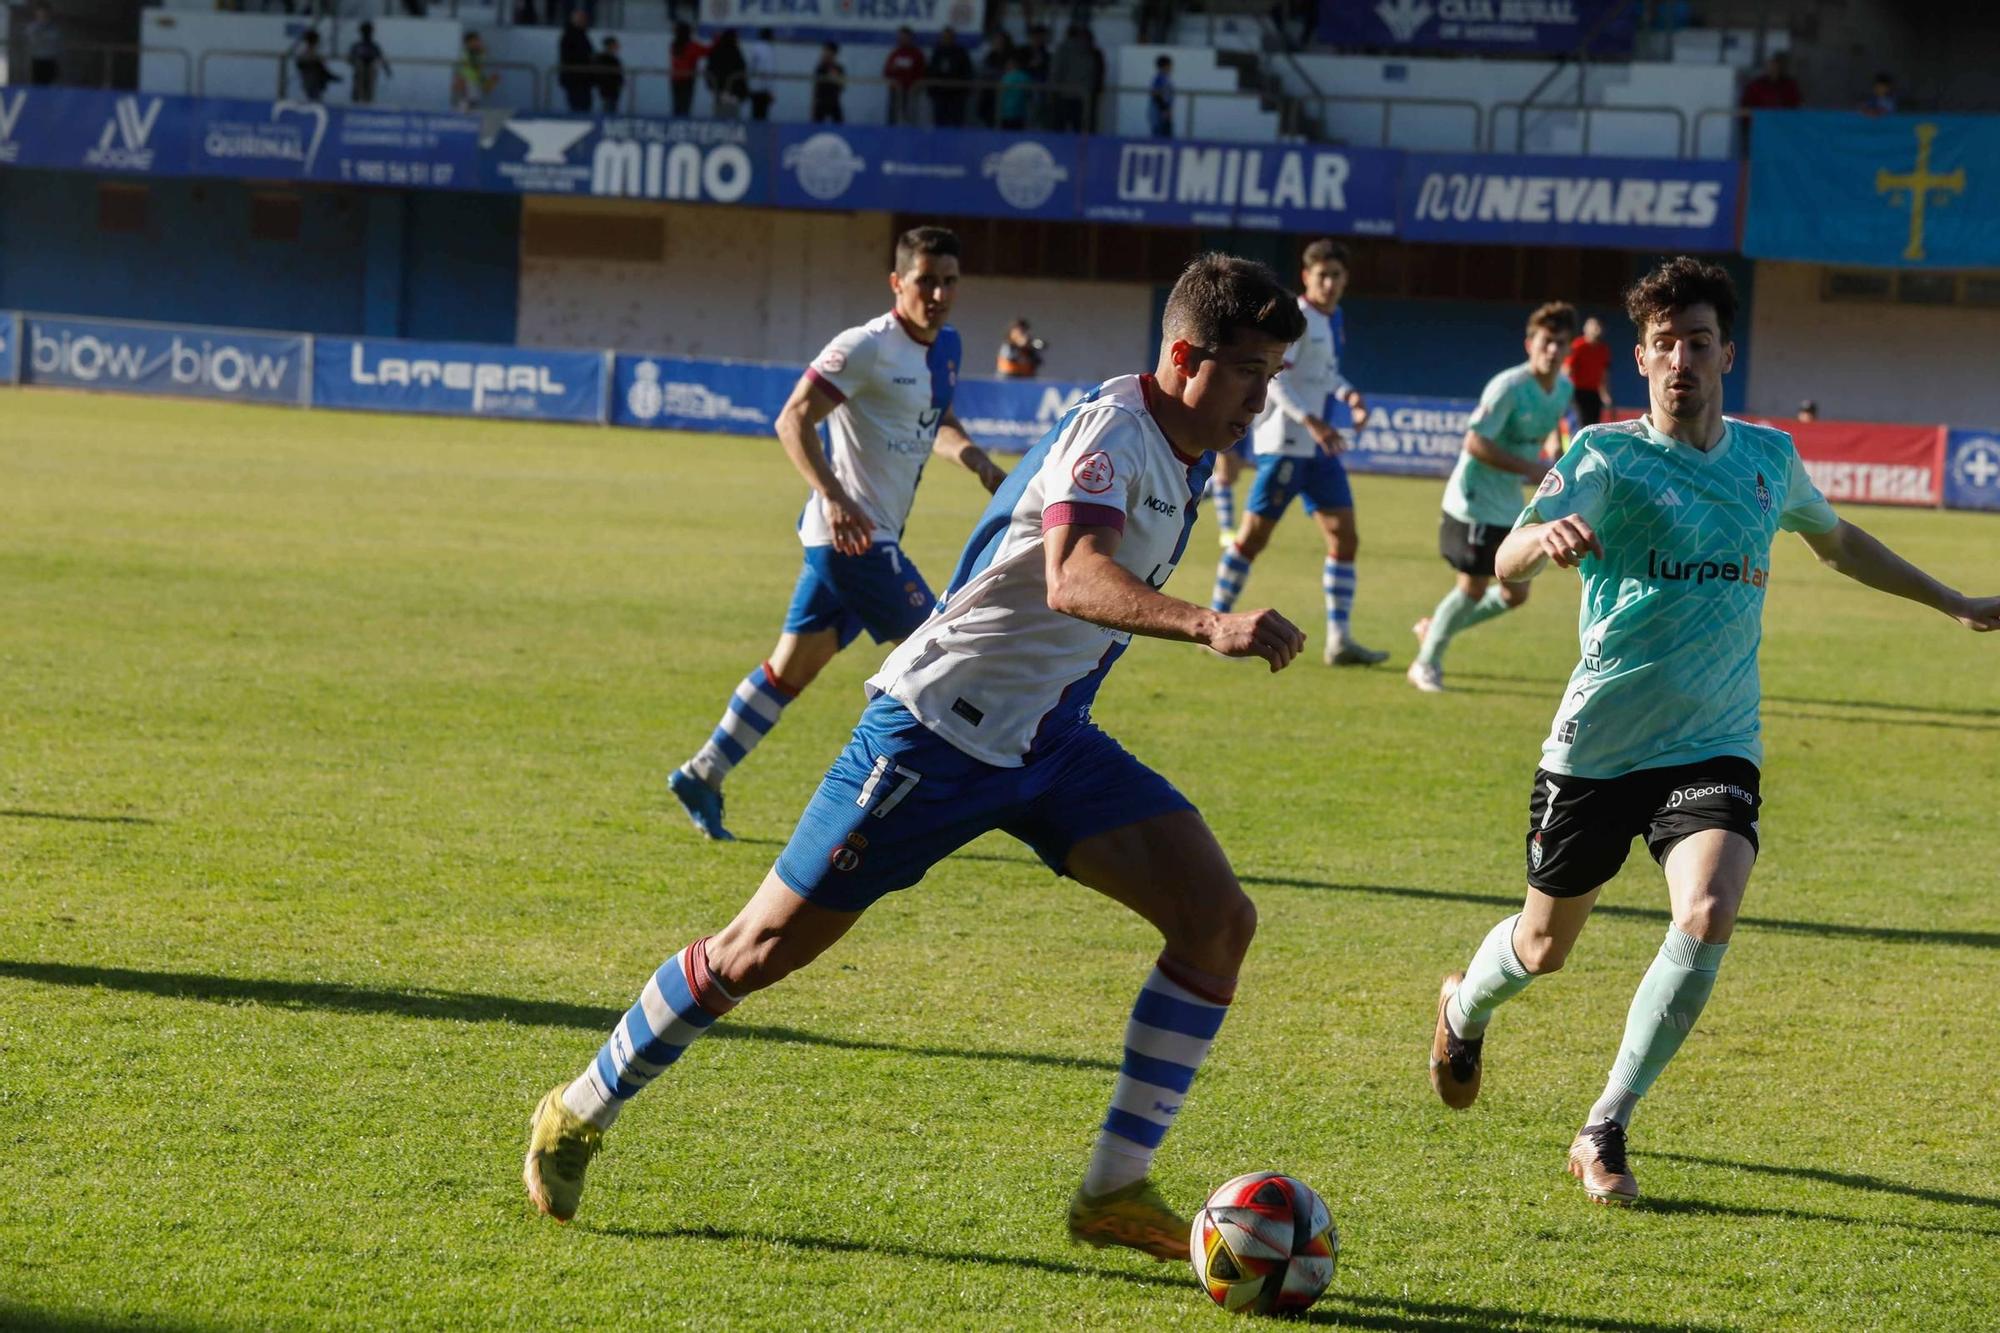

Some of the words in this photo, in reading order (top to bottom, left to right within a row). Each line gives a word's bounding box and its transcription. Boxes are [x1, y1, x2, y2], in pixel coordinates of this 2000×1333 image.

[1175, 147, 1350, 211] MILAR
[1478, 175, 1721, 228] NEVARES
[882, 545, 902, 575] 7
[855, 754, 922, 820] 17
[1539, 779, 1561, 829] 7
[1684, 784, 1754, 806] Geodrilling
